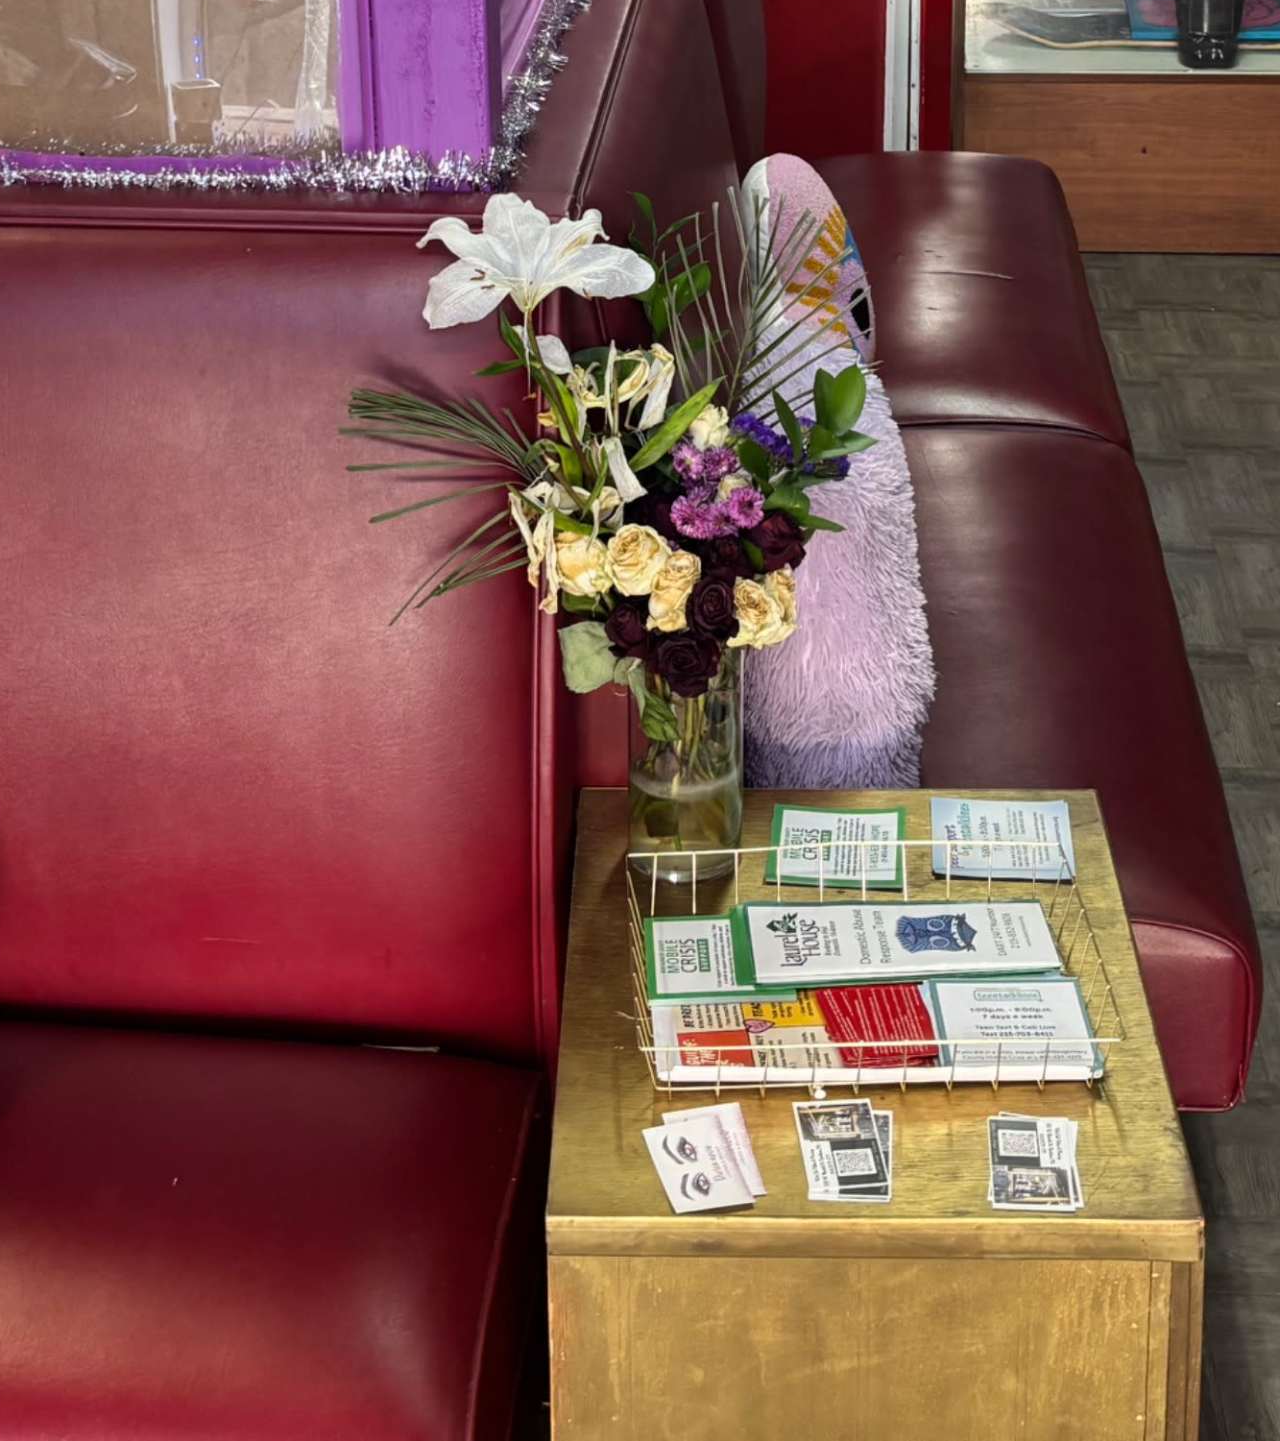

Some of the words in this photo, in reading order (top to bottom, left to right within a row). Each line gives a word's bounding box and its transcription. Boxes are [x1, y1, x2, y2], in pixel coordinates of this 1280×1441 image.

[803, 828, 820, 861] CRSIS
[851, 909, 865, 930] Abuse
[871, 910, 885, 930] Team
[775, 935, 807, 967] Laurel
[798, 919, 821, 957] House
[855, 931, 871, 965] Domestic
[876, 931, 893, 964] Response
[665, 939, 681, 974] MOBILE
[679, 938, 698, 974] CRISIS
